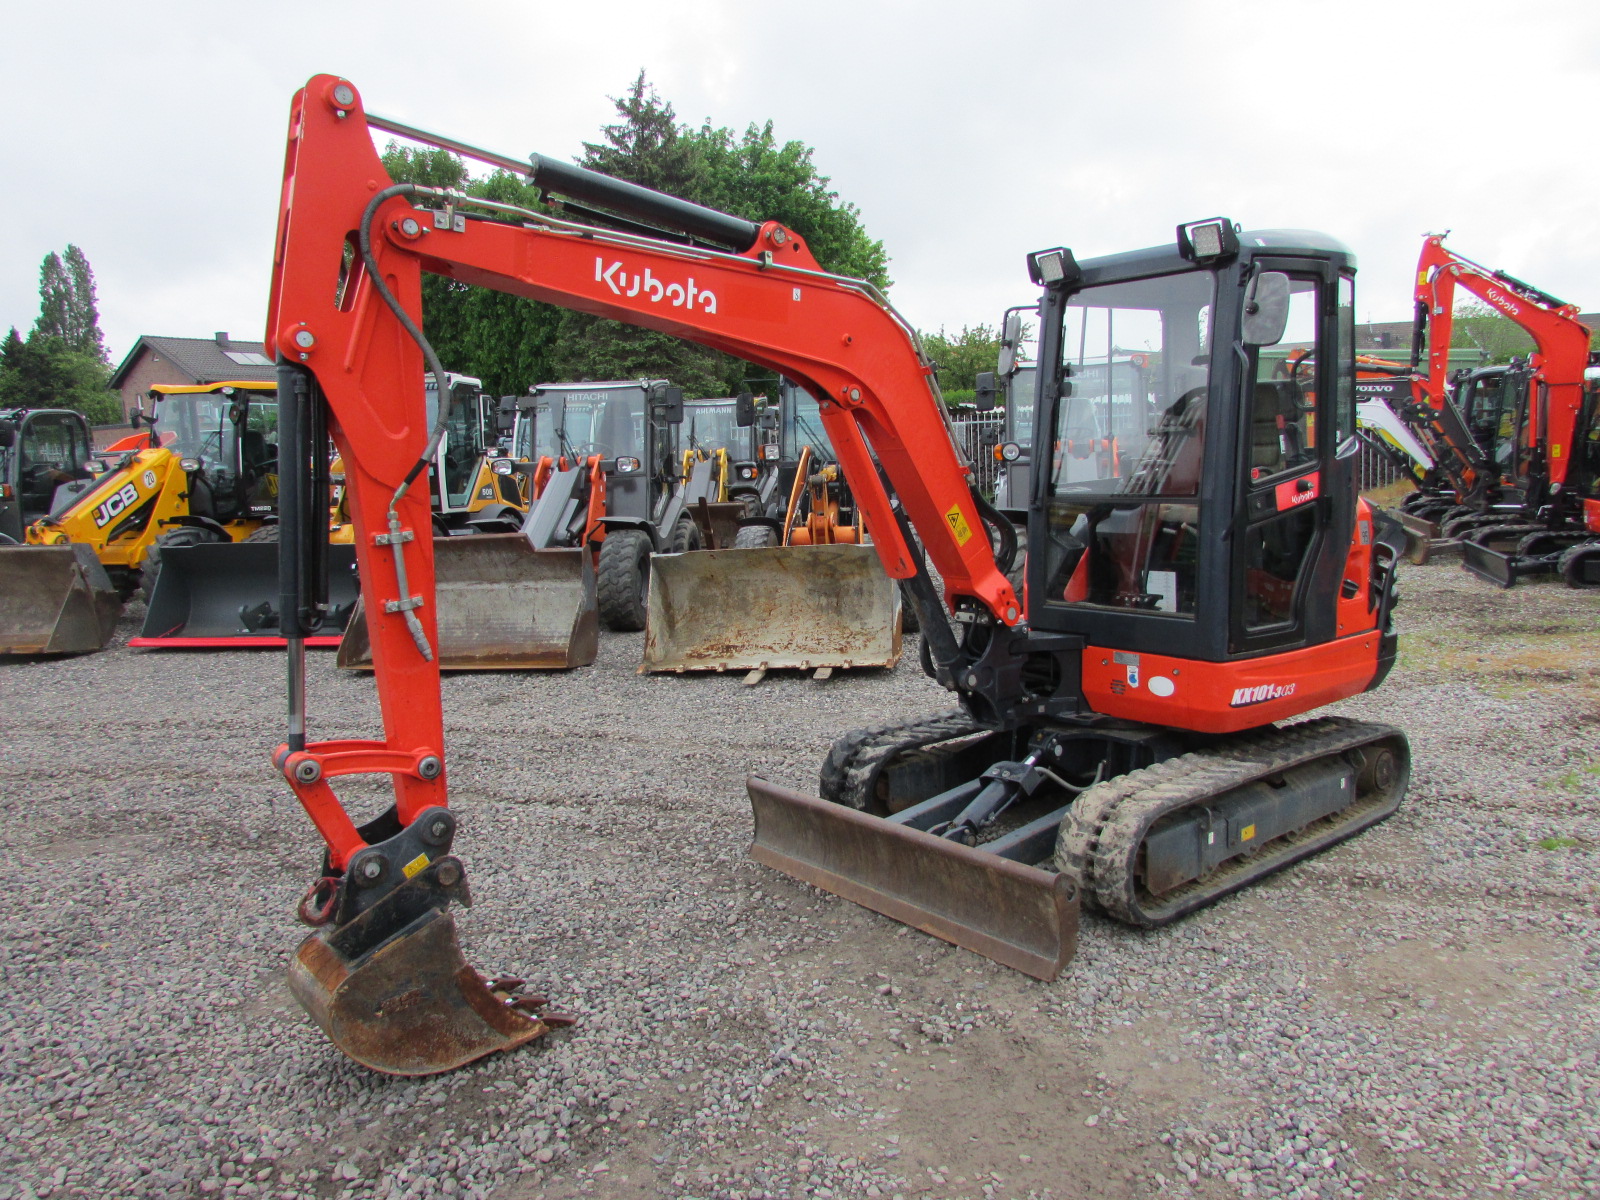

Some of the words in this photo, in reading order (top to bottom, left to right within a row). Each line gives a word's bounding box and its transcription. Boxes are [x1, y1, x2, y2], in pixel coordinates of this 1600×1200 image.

[595, 257, 717, 314] Kubota
[1486, 288, 1519, 316] Kubota
[567, 393, 608, 401] HITACHI
[695, 407, 732, 415] AHLMANN
[96, 483, 139, 527] JCB
[1291, 491, 1314, 504] Kubota
